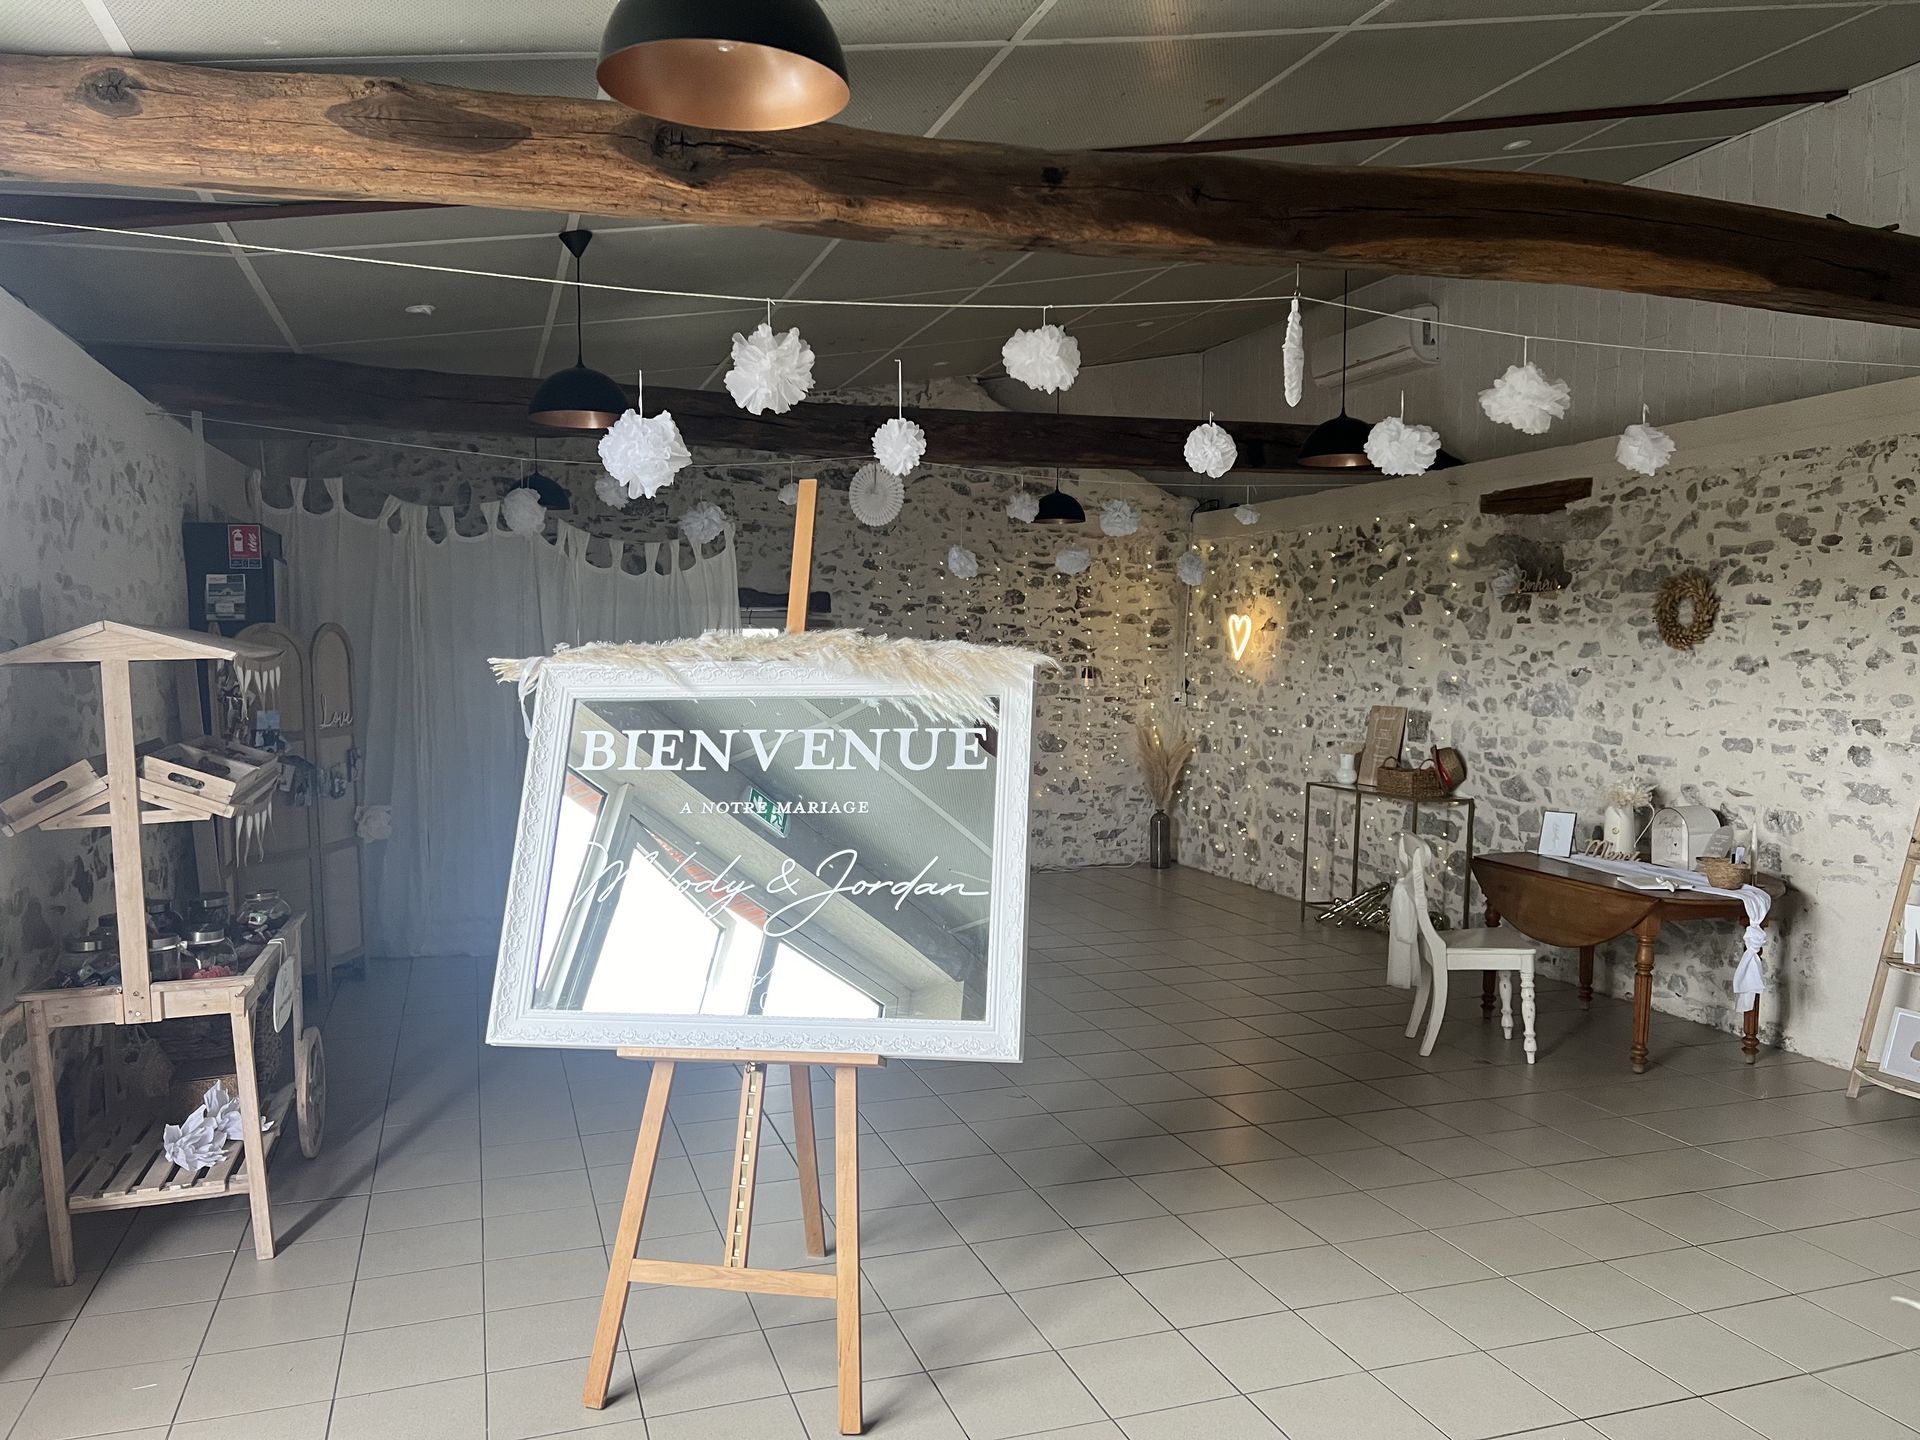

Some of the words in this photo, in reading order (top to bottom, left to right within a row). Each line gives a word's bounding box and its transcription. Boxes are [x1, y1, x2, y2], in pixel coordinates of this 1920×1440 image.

[319, 693, 354, 730] Love
[576, 727, 988, 773] BIENVENUE
[680, 802, 692, 814] A
[700, 802, 767, 814] NOTRE
[777, 801, 869, 814] MARIAGE
[1584, 839, 1642, 863] Merci
[573, 841, 755, 920] Mlody
[763, 849, 989, 937] Jordan
[766, 858, 800, 896] &
